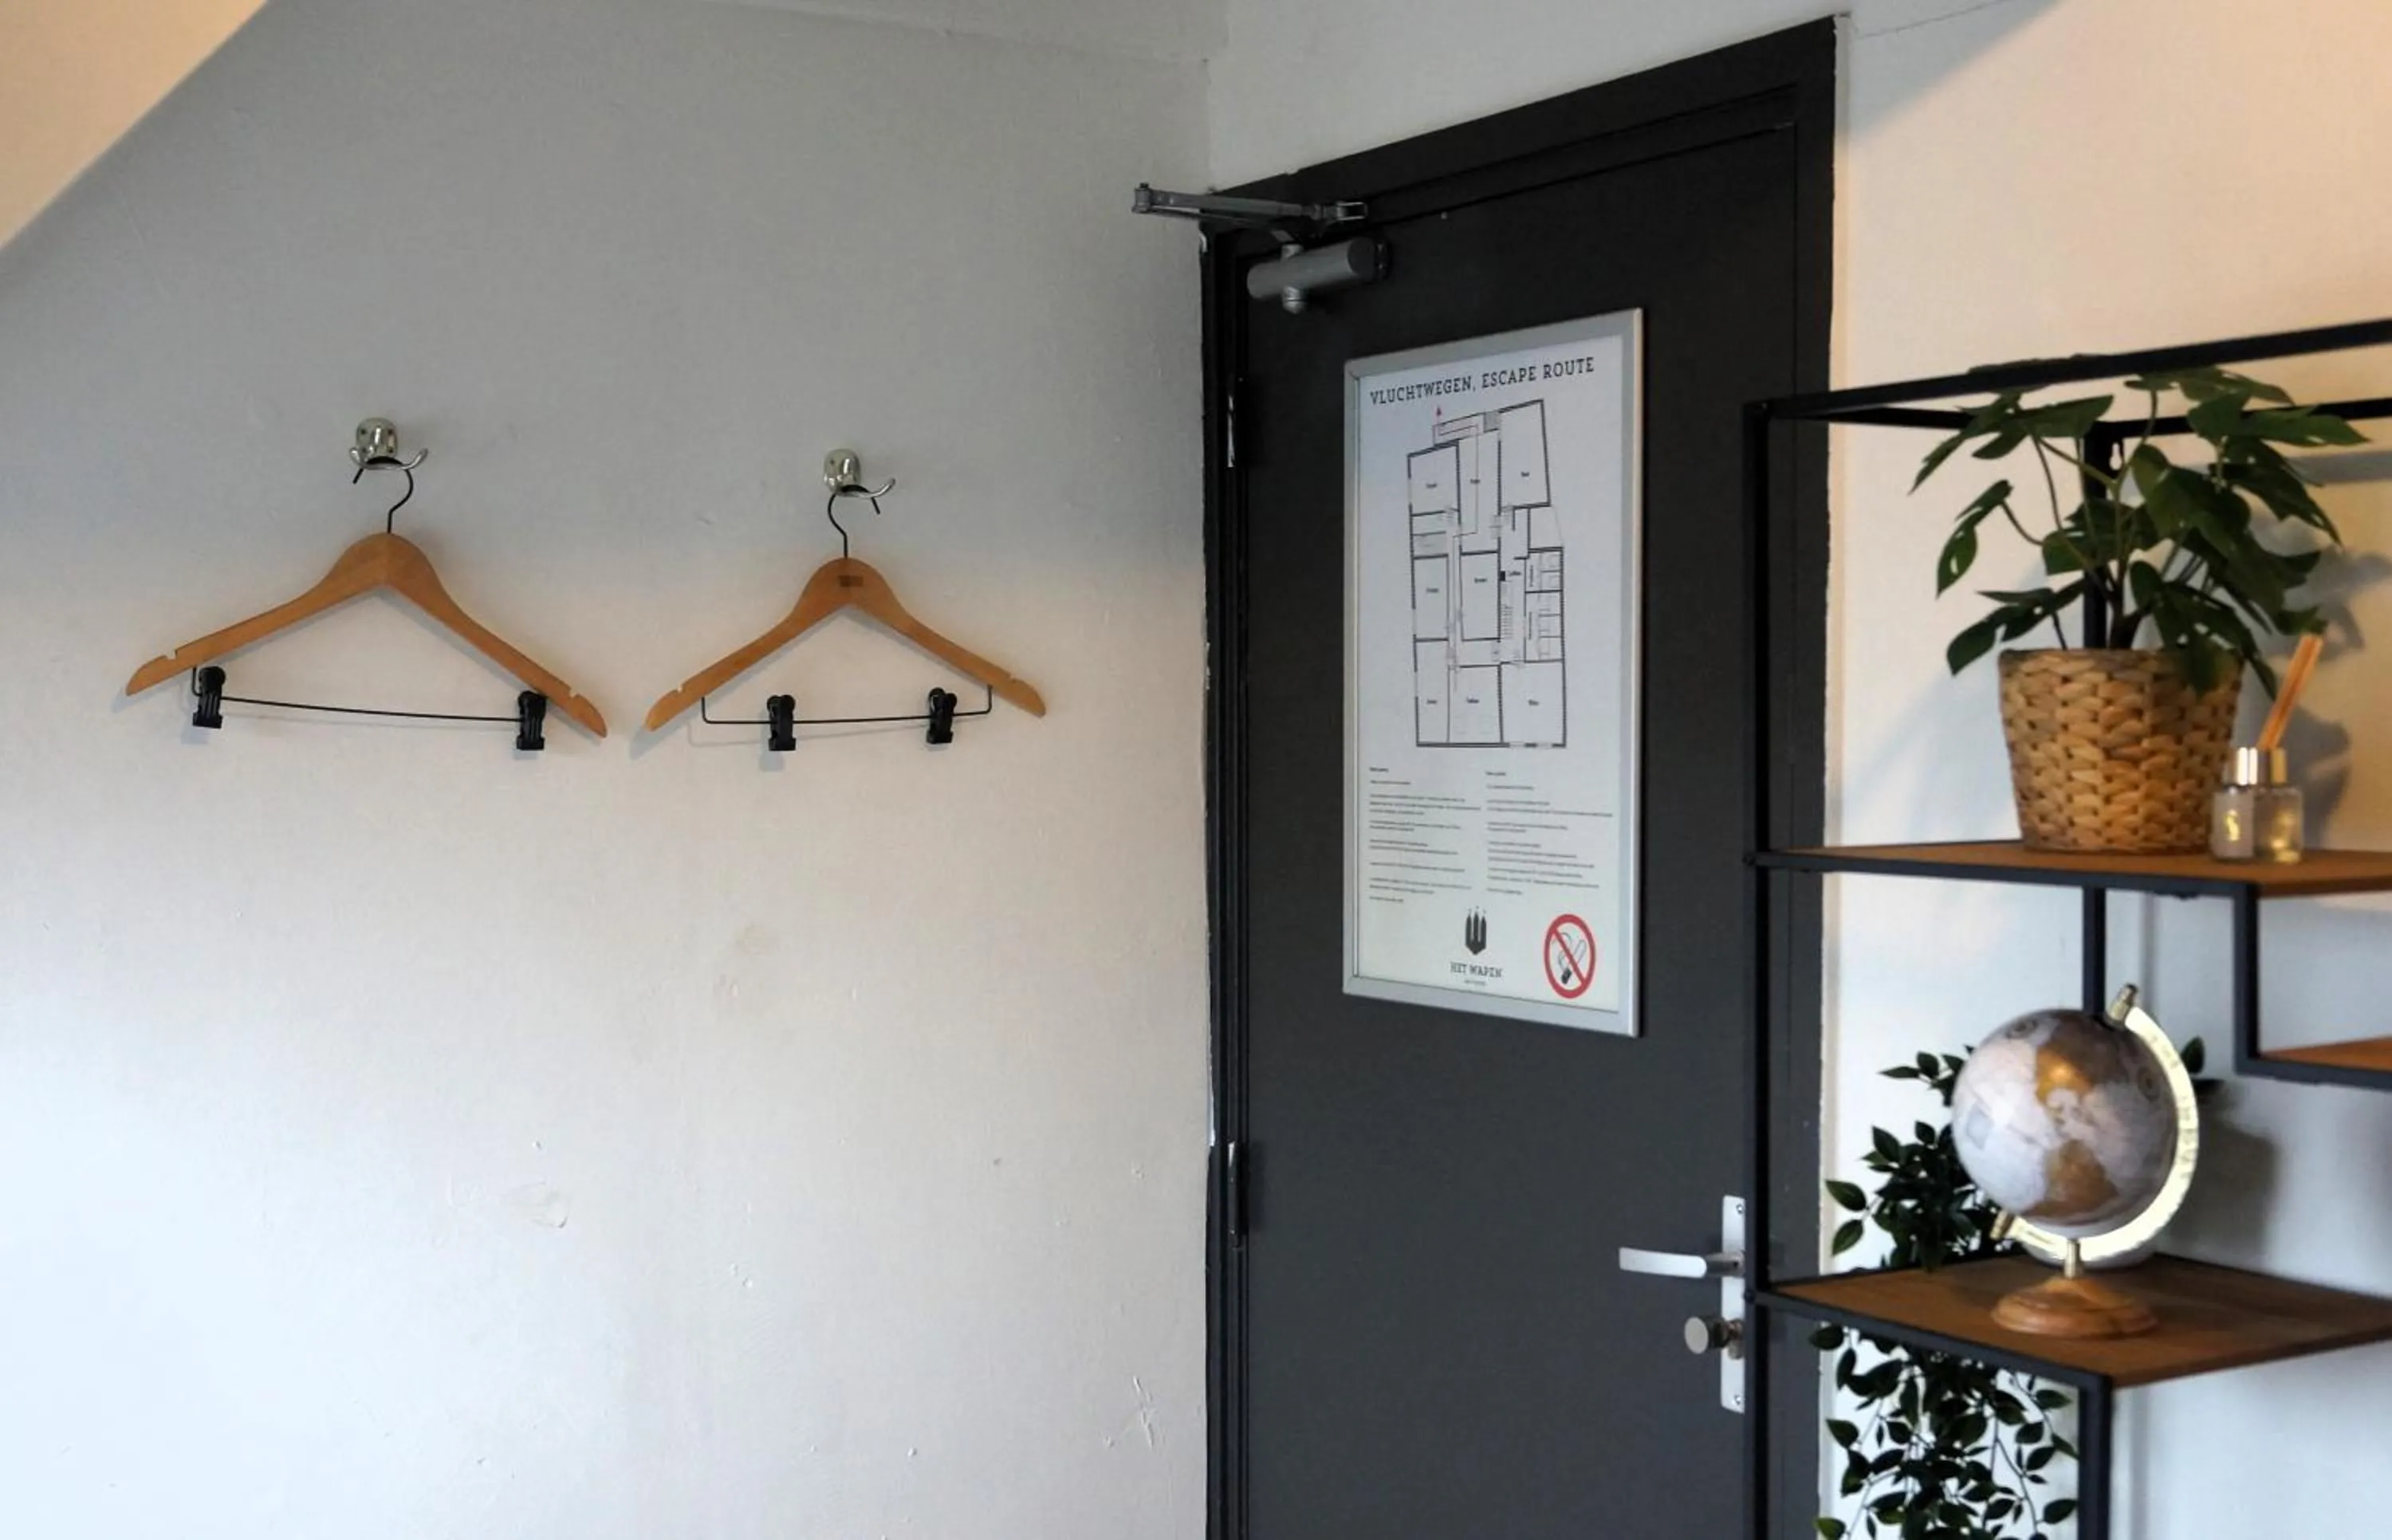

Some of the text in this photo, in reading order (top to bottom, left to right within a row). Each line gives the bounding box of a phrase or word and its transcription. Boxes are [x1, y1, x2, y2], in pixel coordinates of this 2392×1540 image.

[1370, 357, 1595, 405] VLUCHTWEGEN, ESCAPE ROUTE
[1450, 961, 1467, 974] HET
